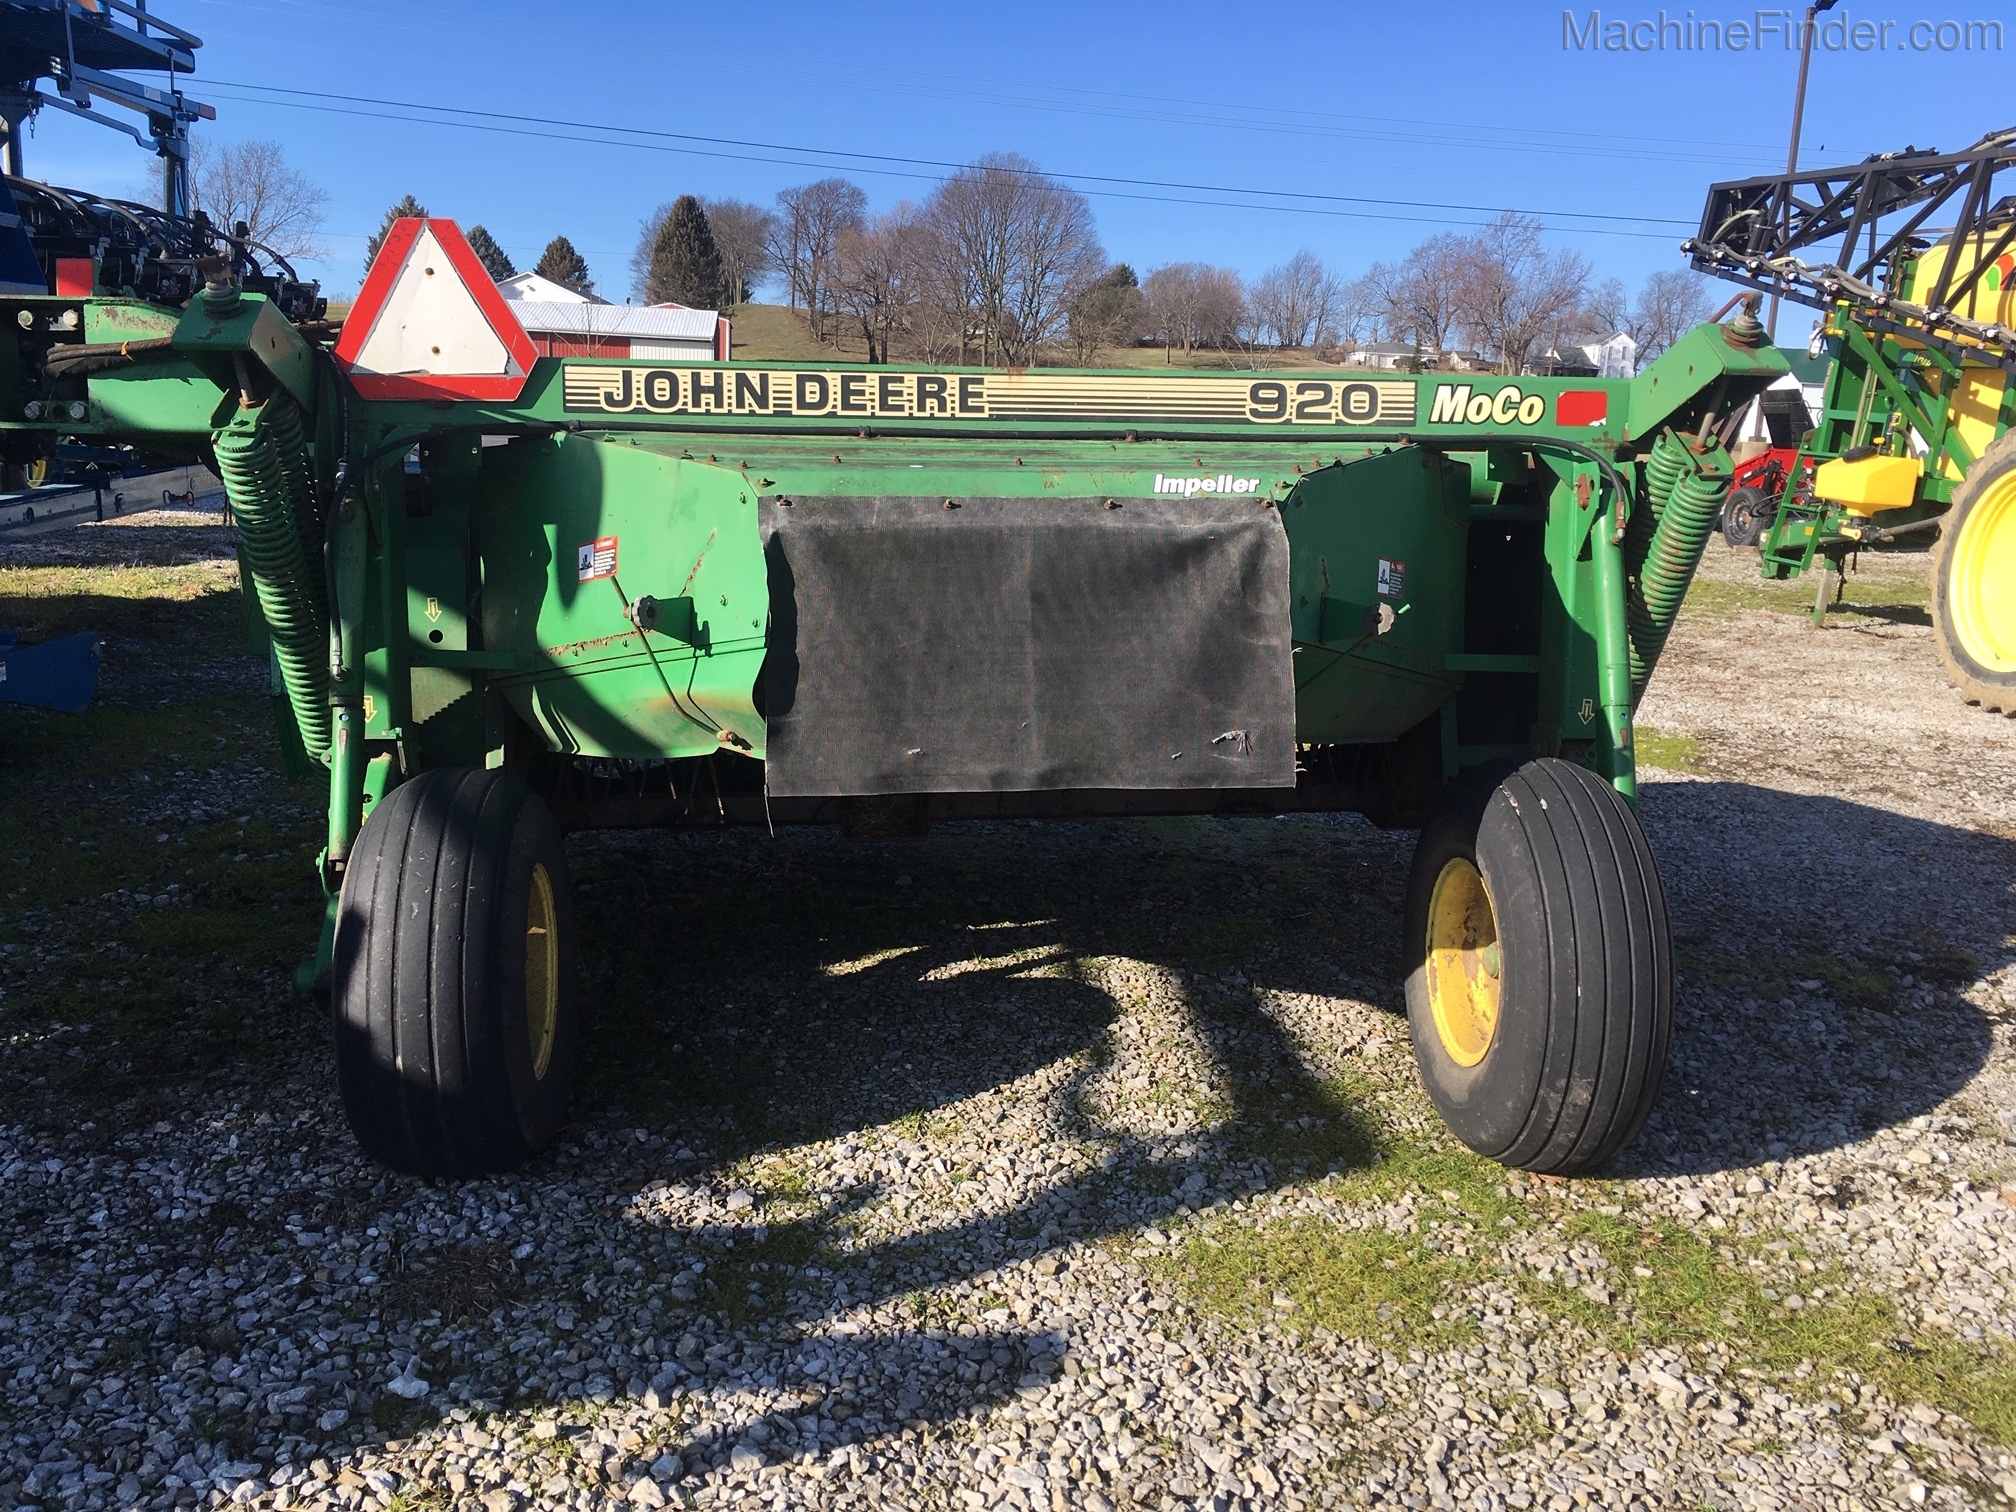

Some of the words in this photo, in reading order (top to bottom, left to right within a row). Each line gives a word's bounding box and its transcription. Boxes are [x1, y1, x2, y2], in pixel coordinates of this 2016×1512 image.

[602, 369, 772, 412] JOHN
[794, 373, 987, 416] DEERE
[1247, 381, 1381, 423] 920
[1429, 384, 1546, 425] MoCo
[1153, 473, 1260, 498] Impeller
